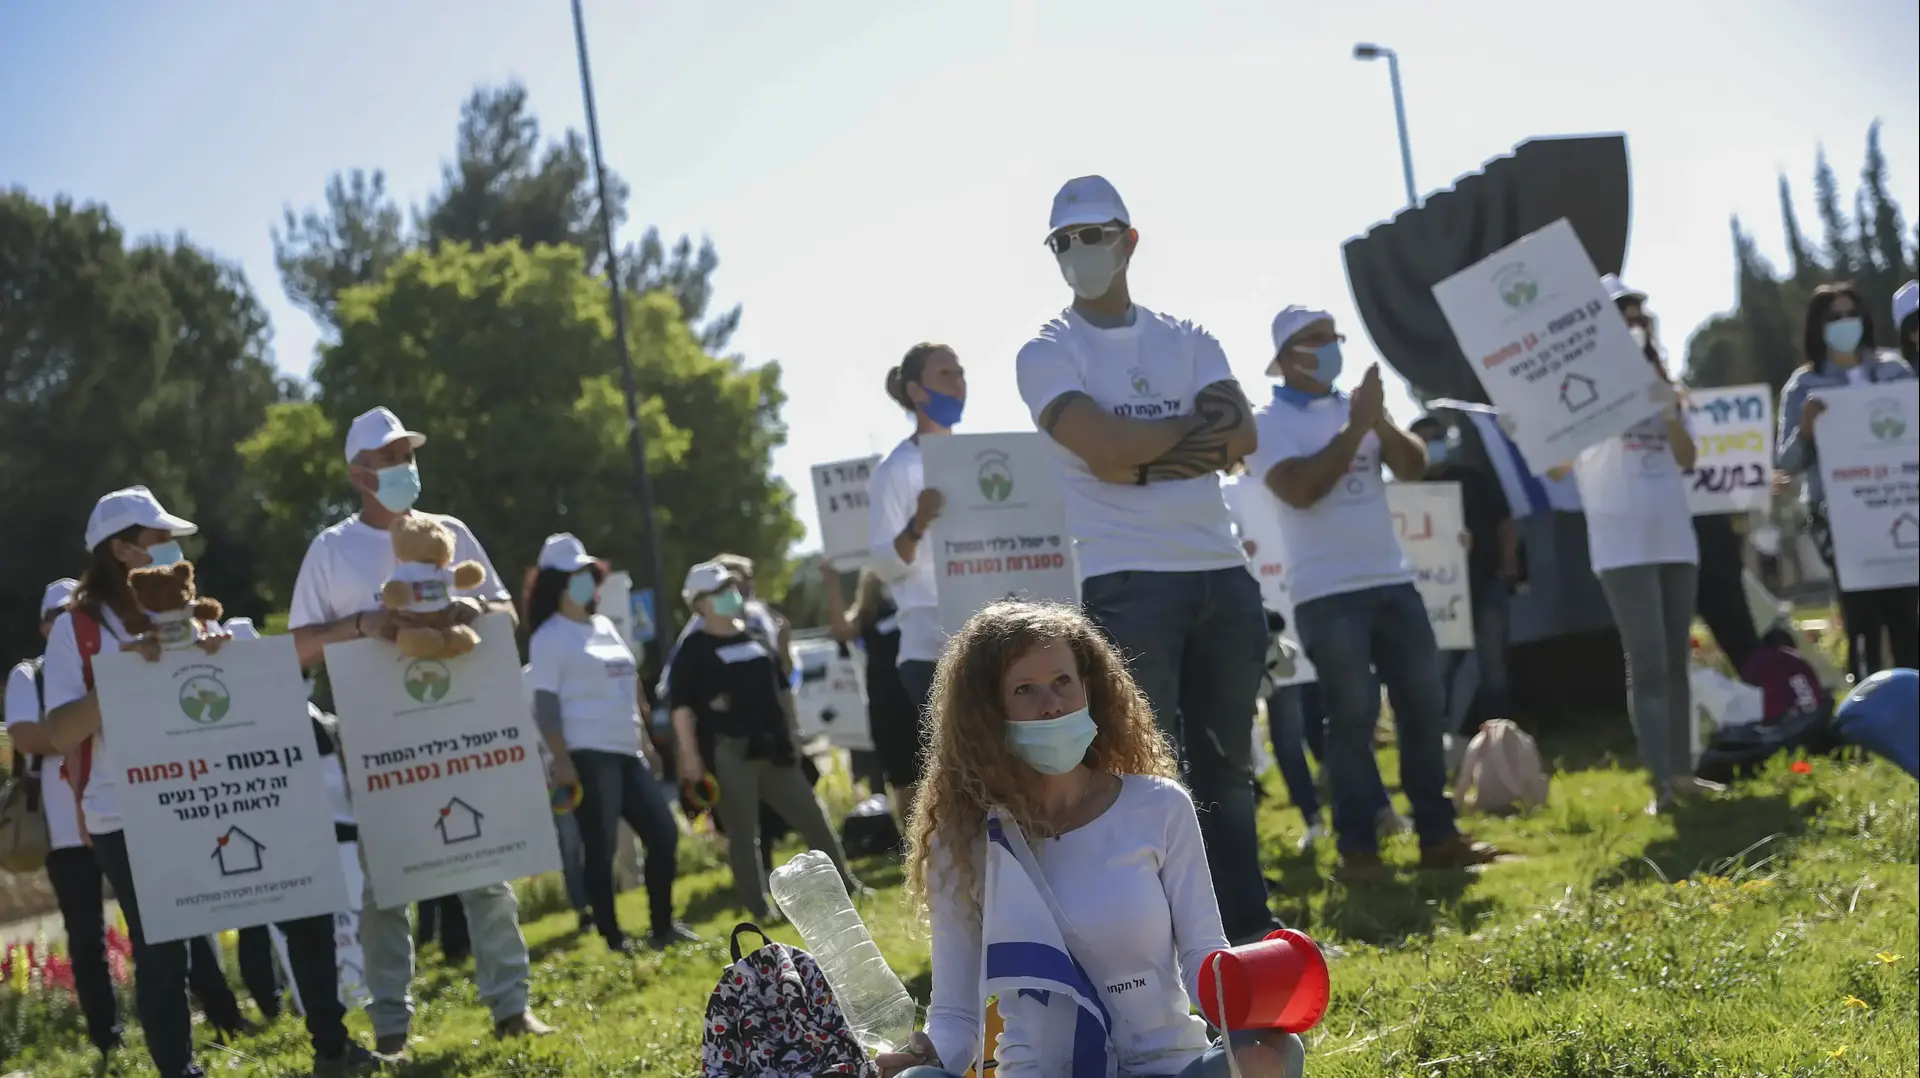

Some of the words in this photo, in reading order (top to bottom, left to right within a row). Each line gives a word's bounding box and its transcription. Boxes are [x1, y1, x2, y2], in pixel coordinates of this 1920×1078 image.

[1163, 399, 1181, 412] אל
[461, 729, 498, 748] יטפל
[502, 726, 519, 740] מי
[419, 738, 459, 756] בילדי
[227, 749, 280, 772] בטוח
[285, 746, 303, 768] גן
[362, 746, 416, 769] המחר?
[447, 744, 525, 775] מסגרות
[127, 761, 184, 785] פתוח
[191, 758, 209, 781] גן
[367, 763, 441, 792] נסגרות
[221, 781, 241, 796] כל
[246, 777, 266, 793] לא
[271, 775, 289, 790] זה
[158, 788, 195, 806] נעים
[199, 785, 219, 801] כך
[214, 801, 229, 819] גן
[233, 794, 280, 812] לראות
[174, 804, 210, 821] סגור
[1107, 981, 1132, 994] תקחו
[1133, 977, 1146, 987] אל
